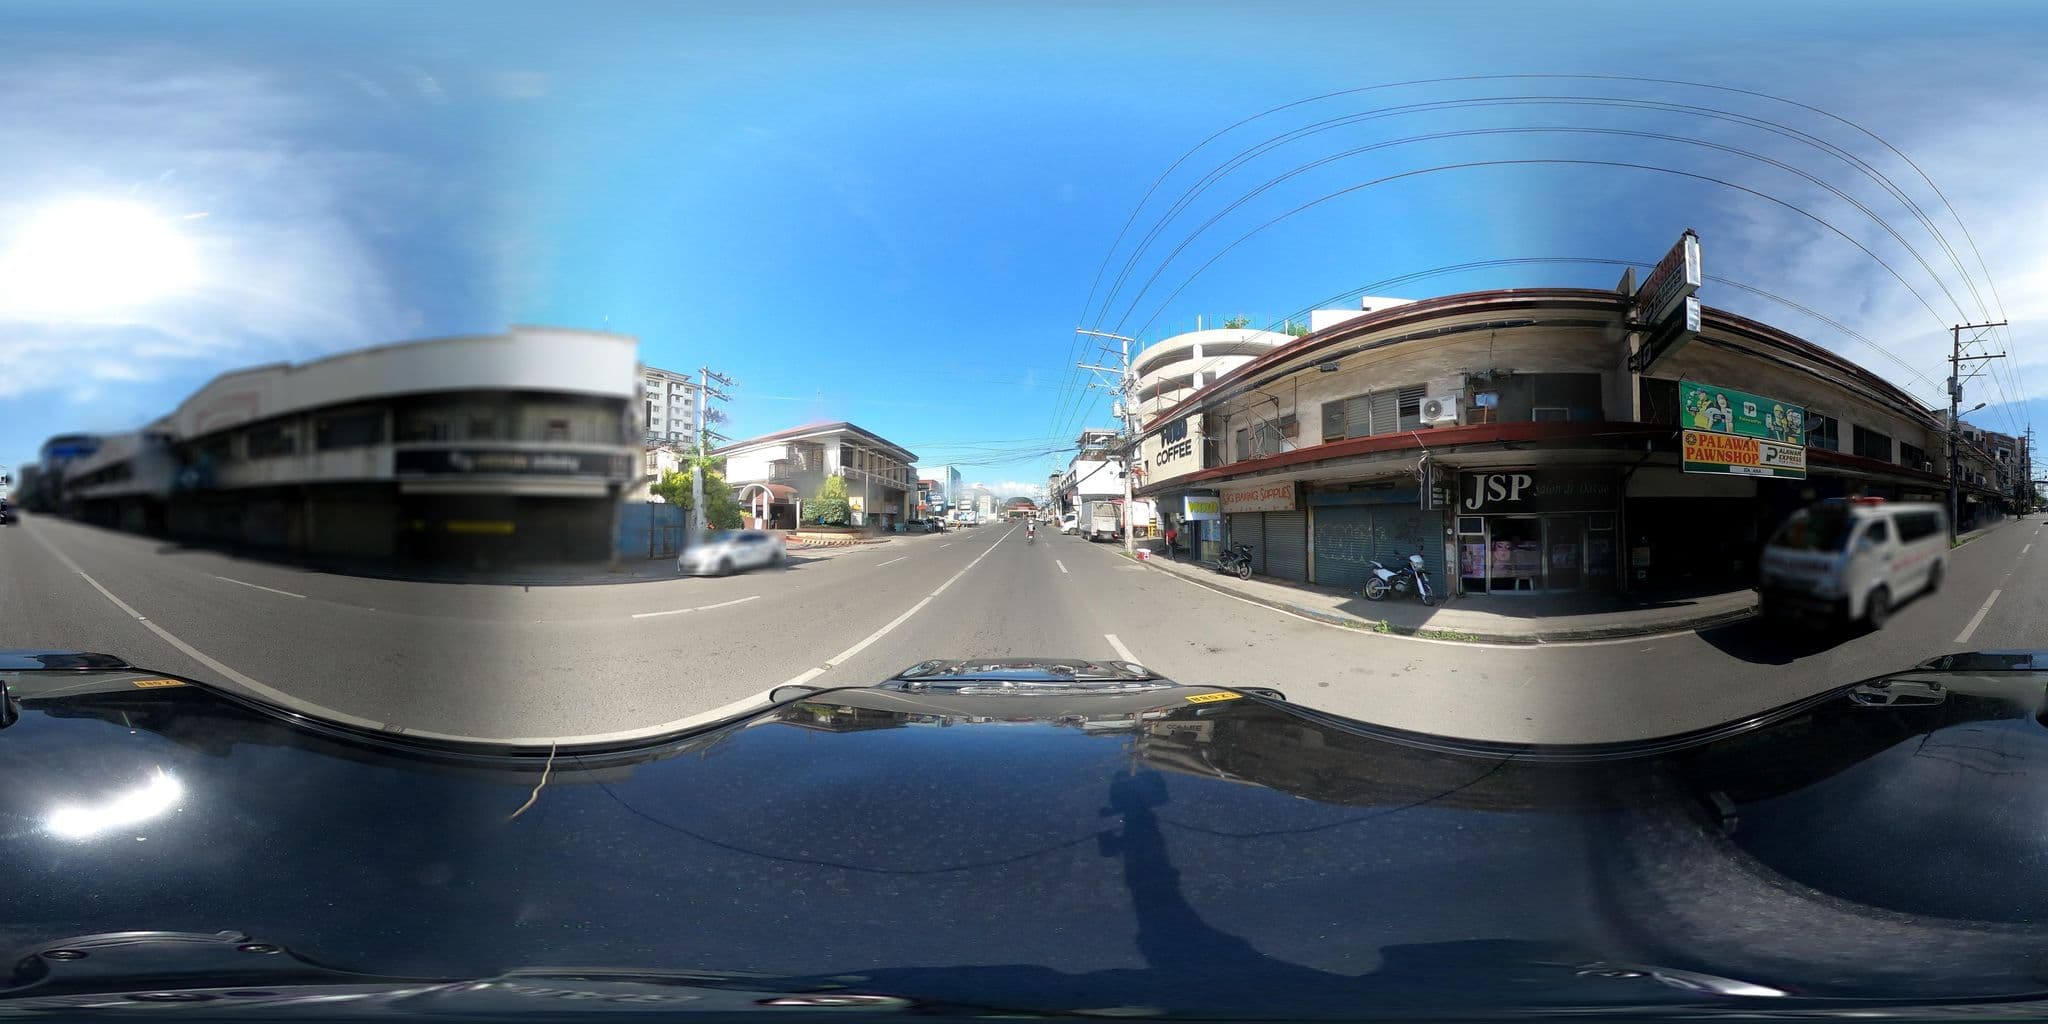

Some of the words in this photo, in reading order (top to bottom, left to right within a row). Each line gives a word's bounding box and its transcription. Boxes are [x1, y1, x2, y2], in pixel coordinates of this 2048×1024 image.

[1157, 438, 1192, 467] COFFEE
[1698, 433, 1760, 453] PALAWAN
[1685, 446, 1760, 465] PAWNSHOP
[1260, 485, 1291, 501] SUPPLIES
[1465, 473, 1532, 511] JSP
